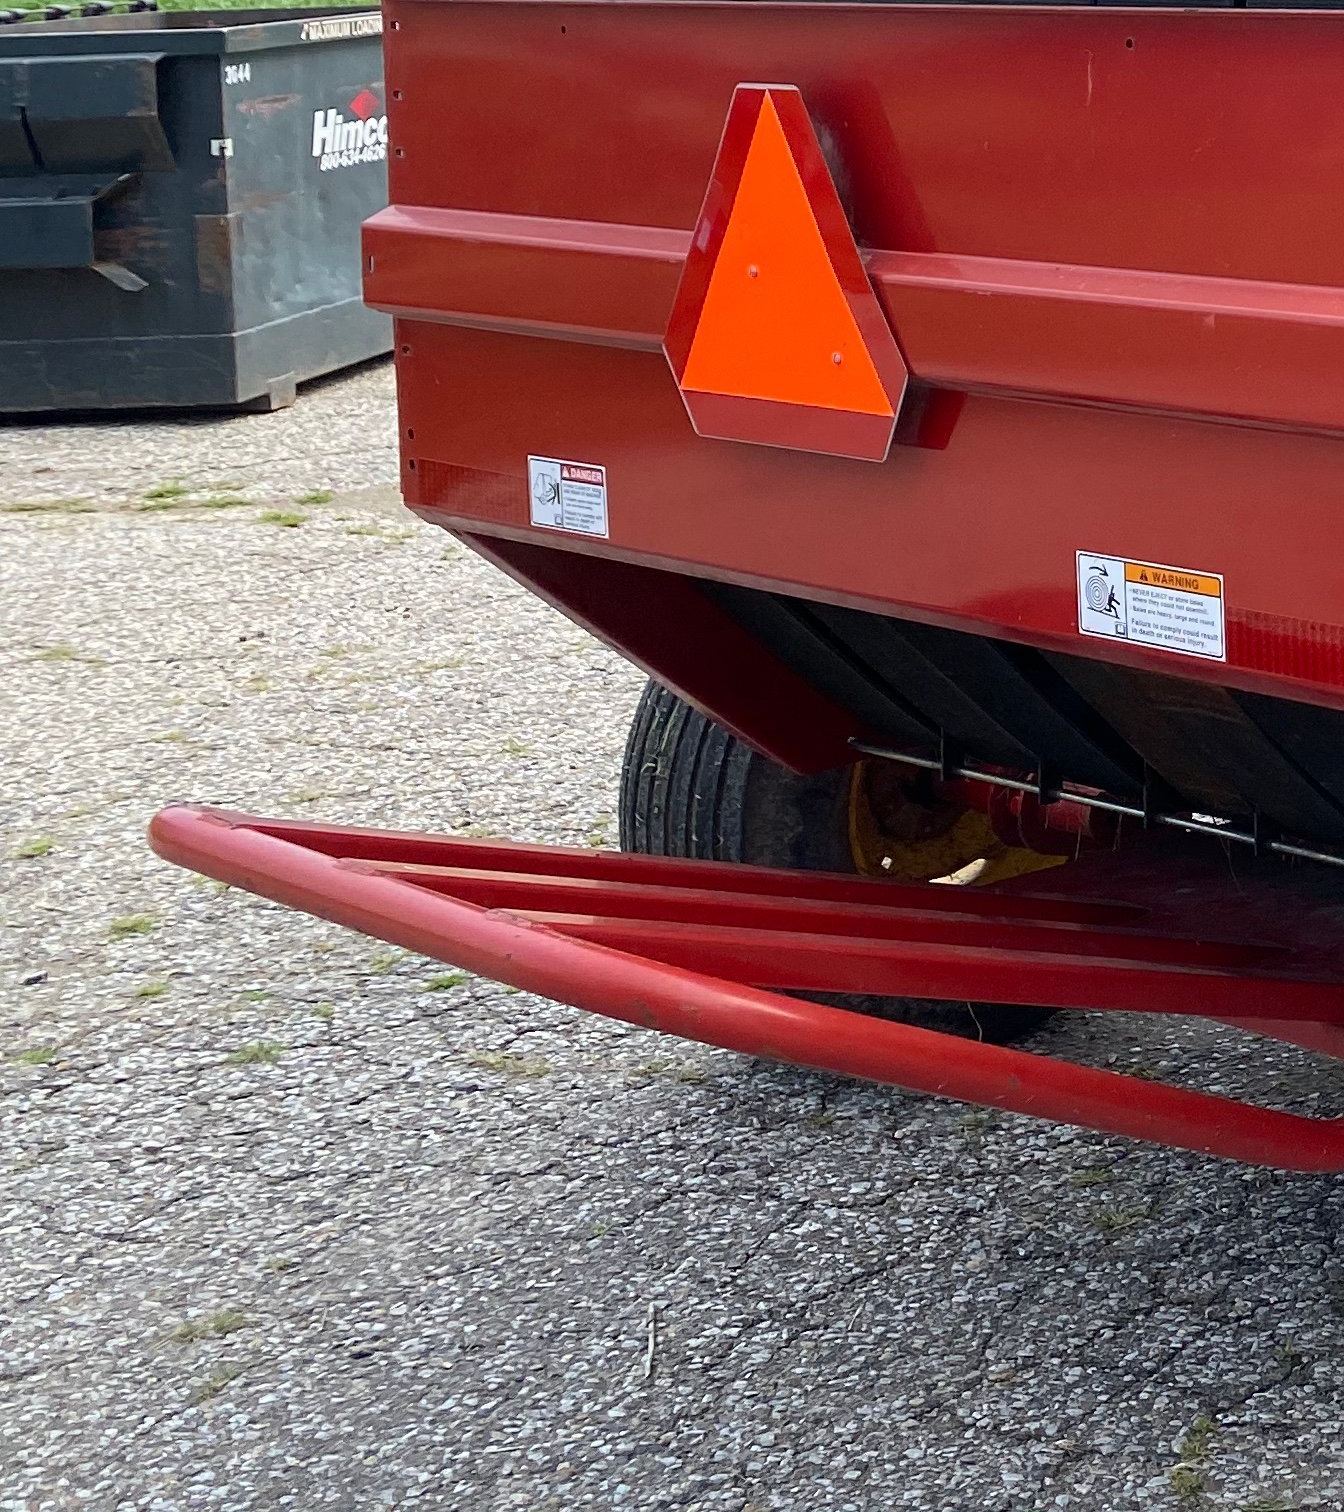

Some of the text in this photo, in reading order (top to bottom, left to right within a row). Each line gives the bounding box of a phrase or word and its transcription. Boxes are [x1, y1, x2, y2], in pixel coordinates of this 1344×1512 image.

[351, 18, 382, 35] LOADIN
[312, 108, 388, 157] Himco
[1152, 572, 1199, 590] WARNING
